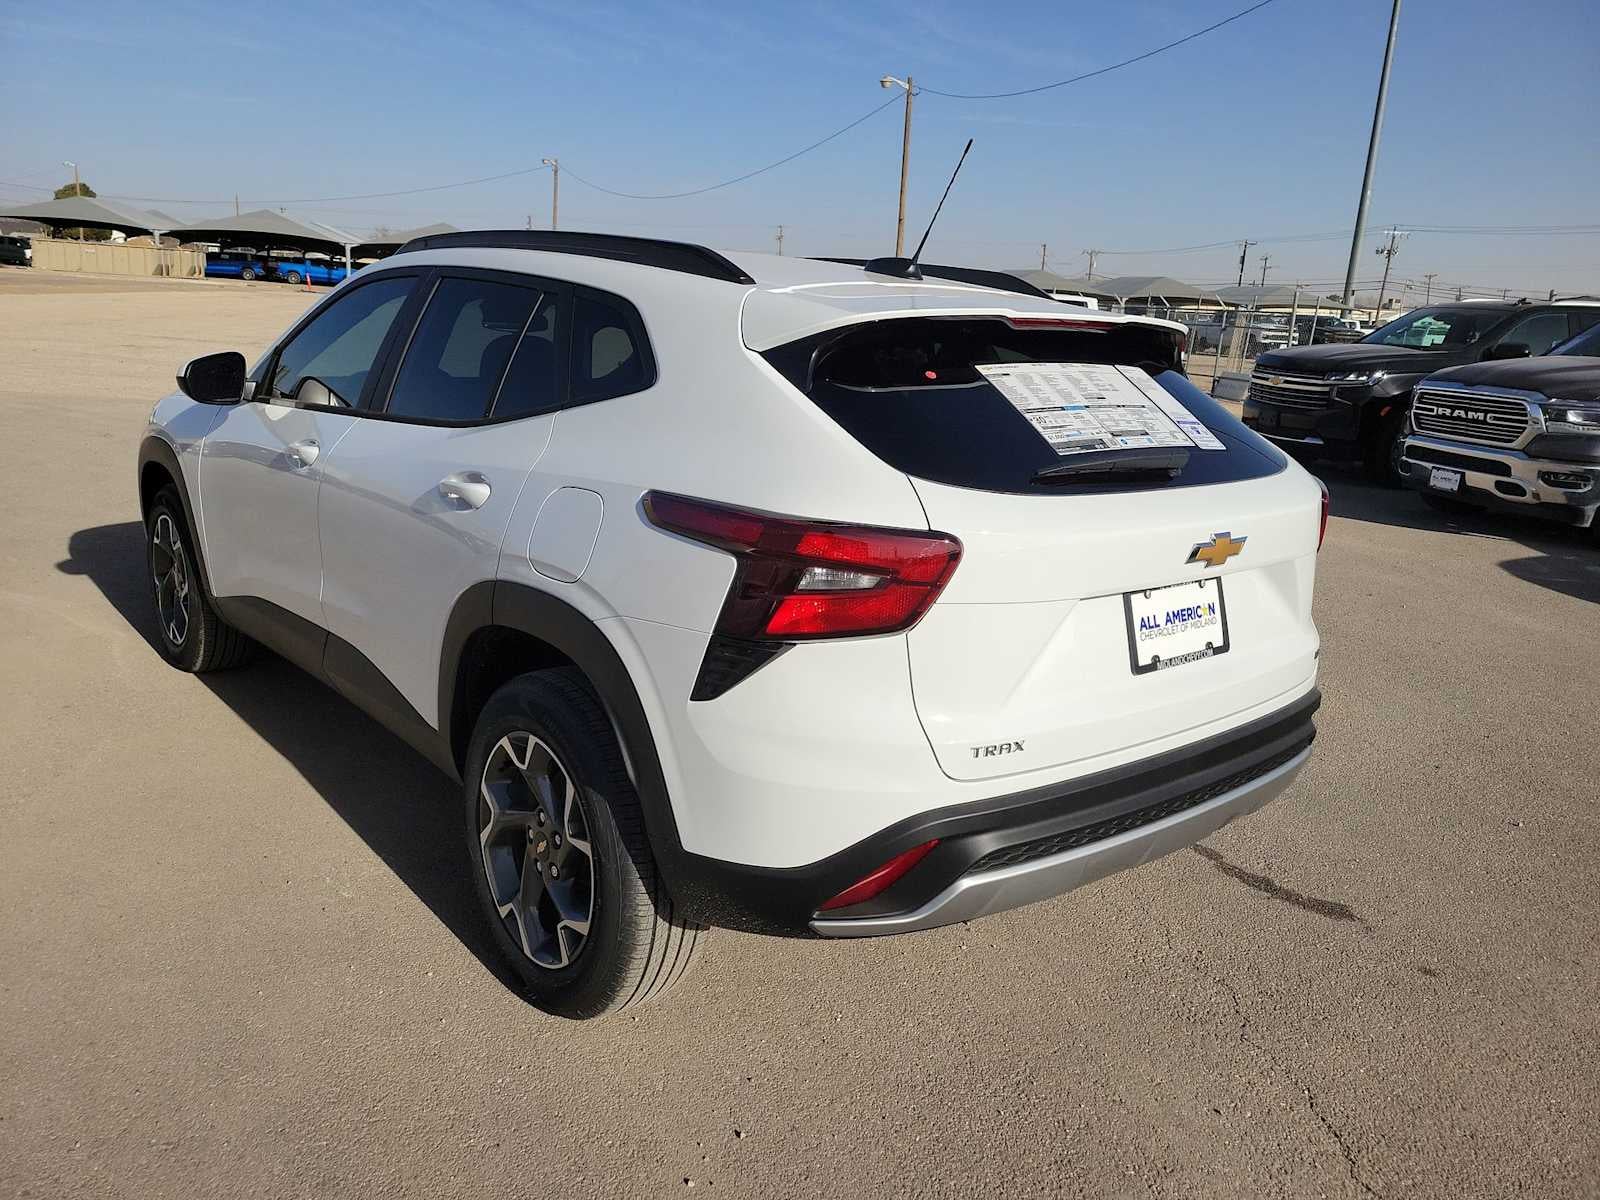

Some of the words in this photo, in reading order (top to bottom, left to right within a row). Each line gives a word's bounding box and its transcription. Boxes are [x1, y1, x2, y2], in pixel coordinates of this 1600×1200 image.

[1437, 407, 1485, 420] RAM
[1140, 615, 1161, 632] ALL
[1140, 624, 1179, 641] CHEVROLET
[1180, 622, 1189, 633] OF
[1190, 616, 1217, 630] MIDLAND
[970, 740, 1024, 758] TRAX
